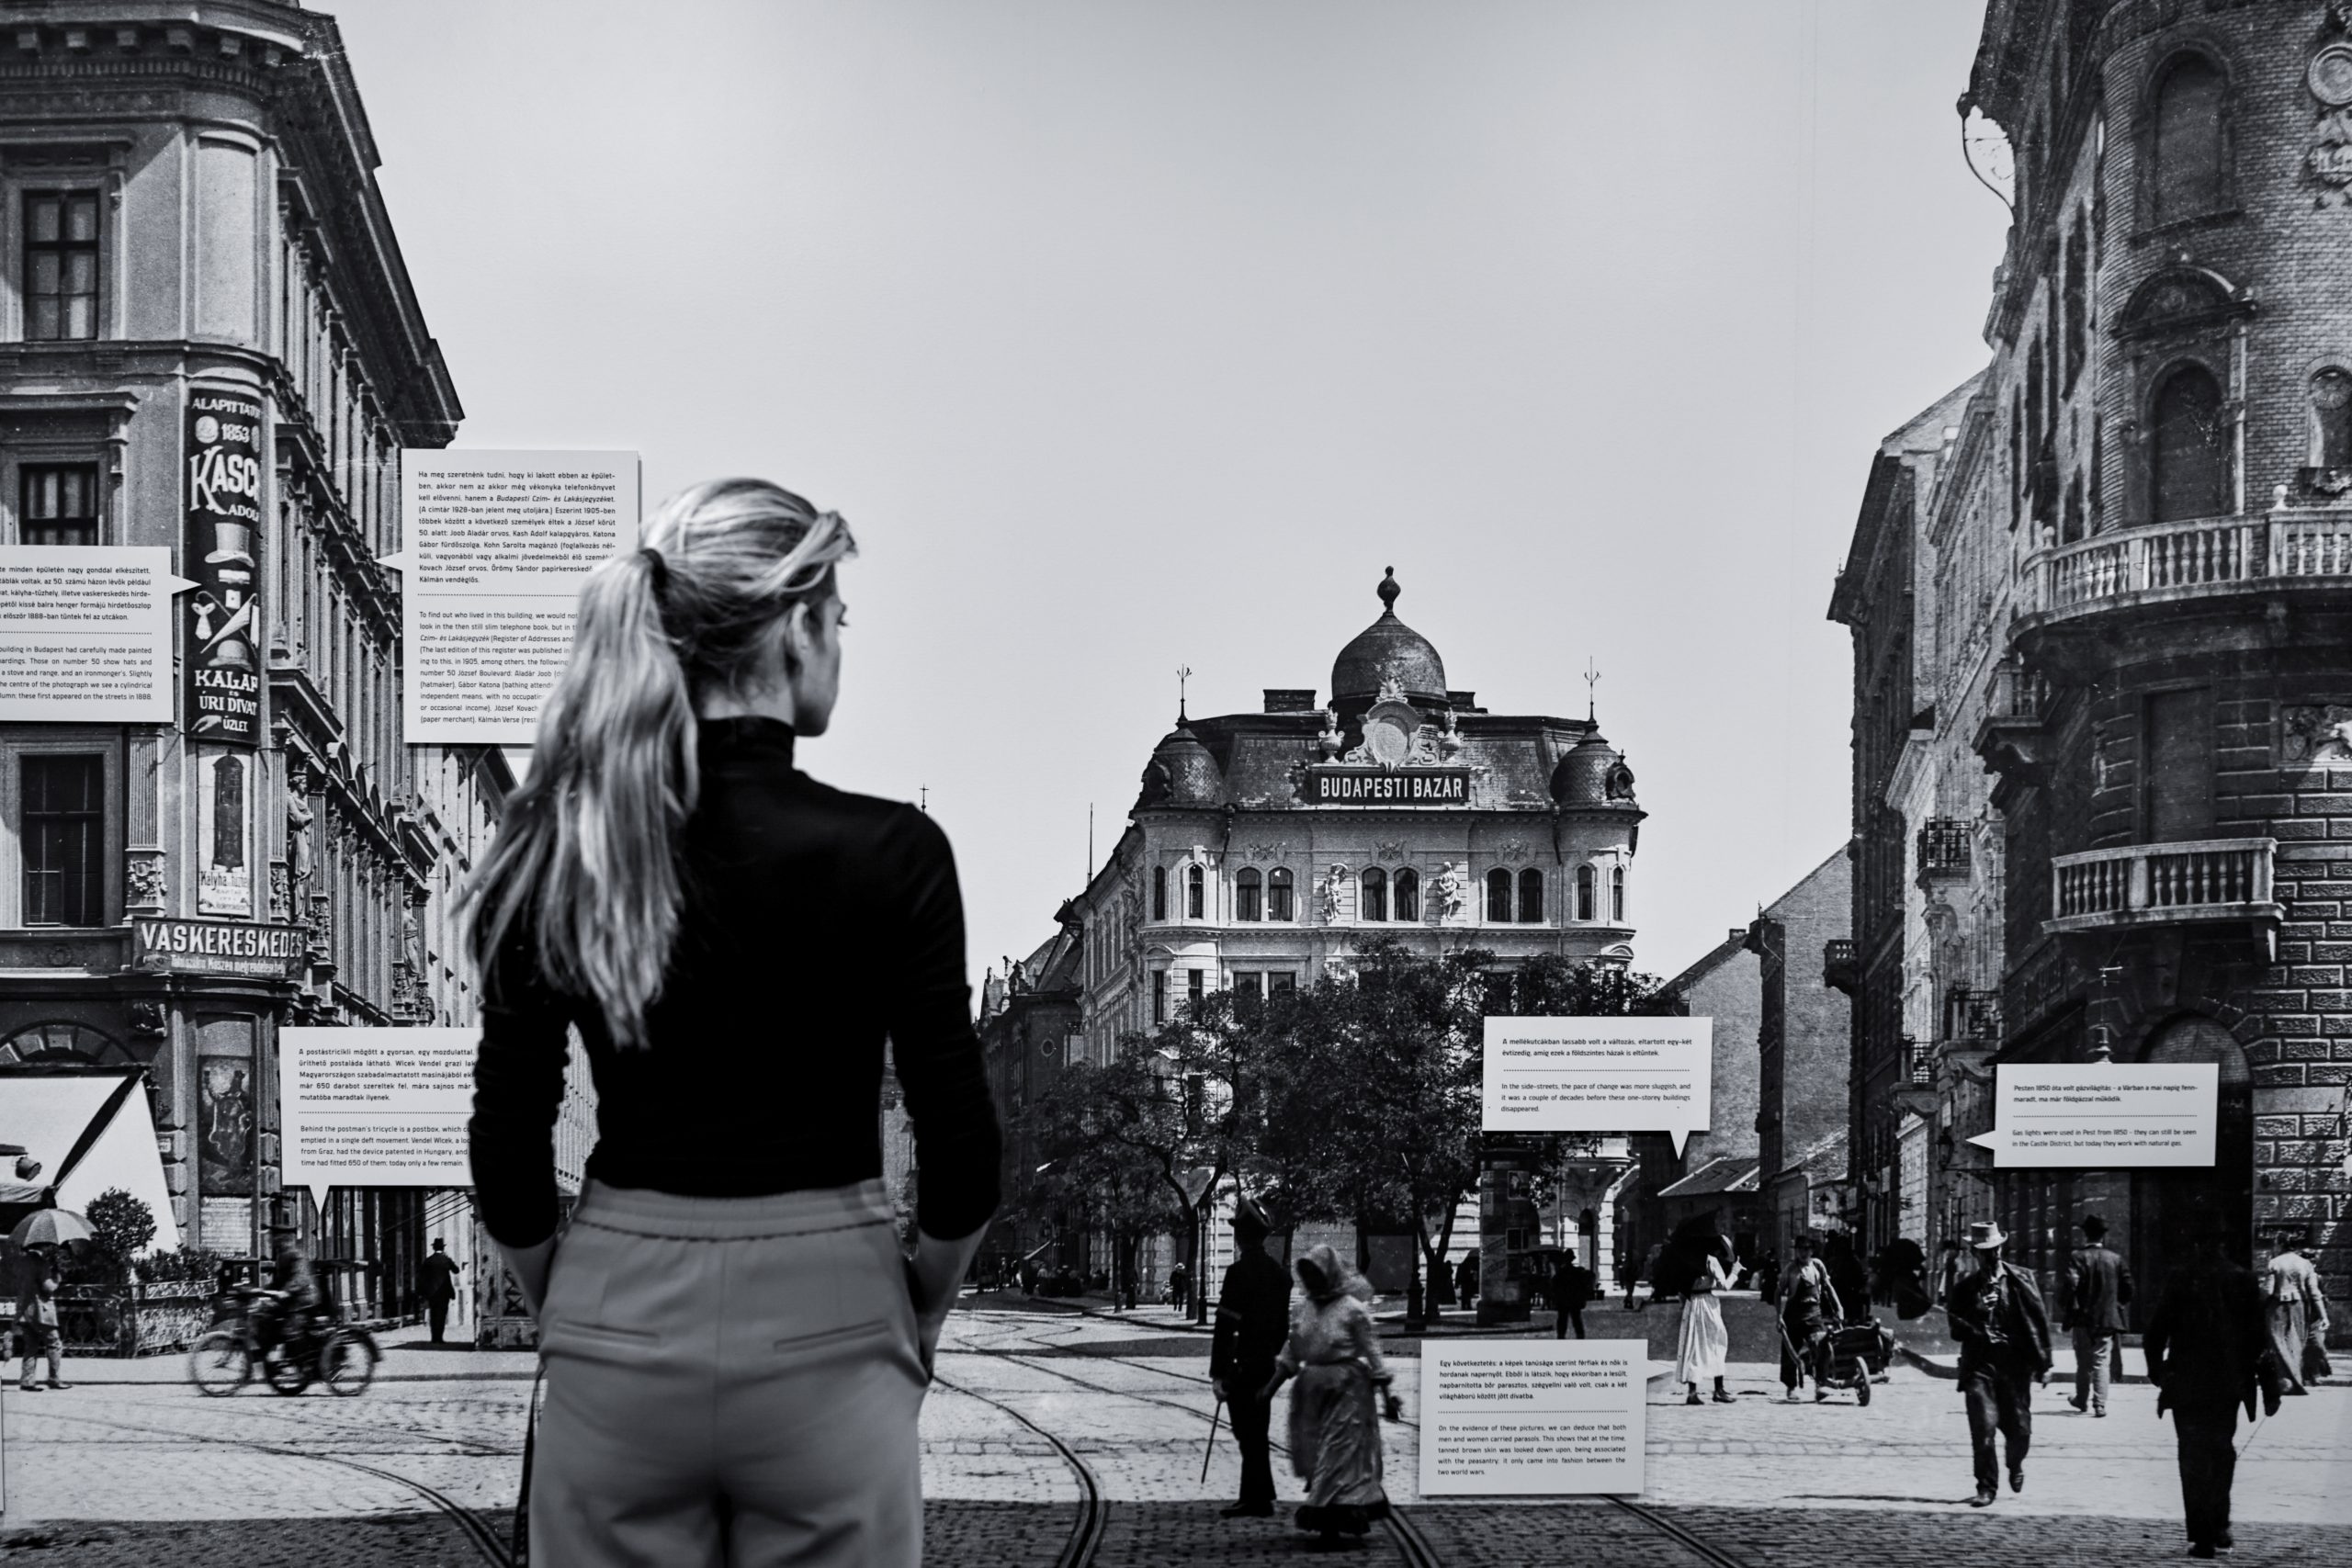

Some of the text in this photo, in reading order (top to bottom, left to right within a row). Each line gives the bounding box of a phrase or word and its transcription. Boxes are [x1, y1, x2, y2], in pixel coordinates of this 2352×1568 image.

[220, 423, 250, 443] 1853
[508, 471, 525, 479] hogy
[558, 471, 579, 479] ebben
[511, 483, 526, 491] még
[528, 483, 561, 491] vékonyka
[564, 483, 616, 492] telefonkönyvet
[511, 518, 546, 526] személyek
[36, 566, 64, 574] épületén
[85, 567, 112, 575] gonddal
[0, 646, 24, 654] uilding
[33, 646, 63, 654] Budapest
[79, 646, 107, 654] carefully
[128, 647, 152, 655] painted
[0, 657, 26, 665] ardings.
[29, 657, 49, 665] Those
[1320, 775, 1463, 798] BUDAPESTI BAZÁR
[432, 1082, 455, 1090] sajnos
[389, 1159, 407, 1168] today
[407, 1159, 421, 1168] only
[1497, 1393, 1509, 1401] jött
